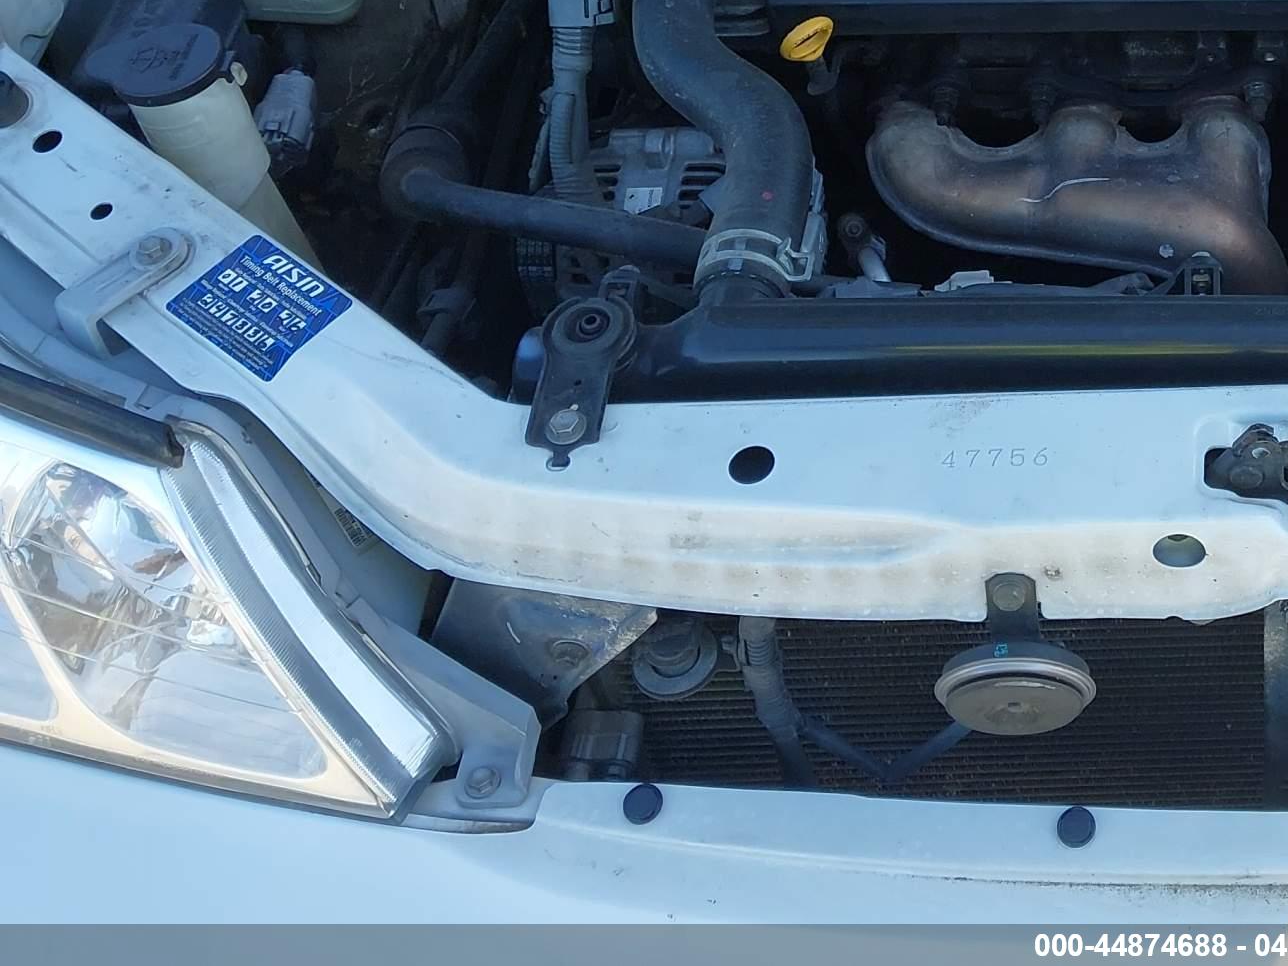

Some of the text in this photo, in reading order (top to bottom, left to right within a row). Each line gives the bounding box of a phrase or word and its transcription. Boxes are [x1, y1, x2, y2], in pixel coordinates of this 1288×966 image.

[240, 255, 265, 278] Timing
[263, 270, 280, 287] Belt
[276, 278, 324, 317] Replacement
[262, 254, 325, 297] AISIN
[941, 447, 1049, 468] 47756
